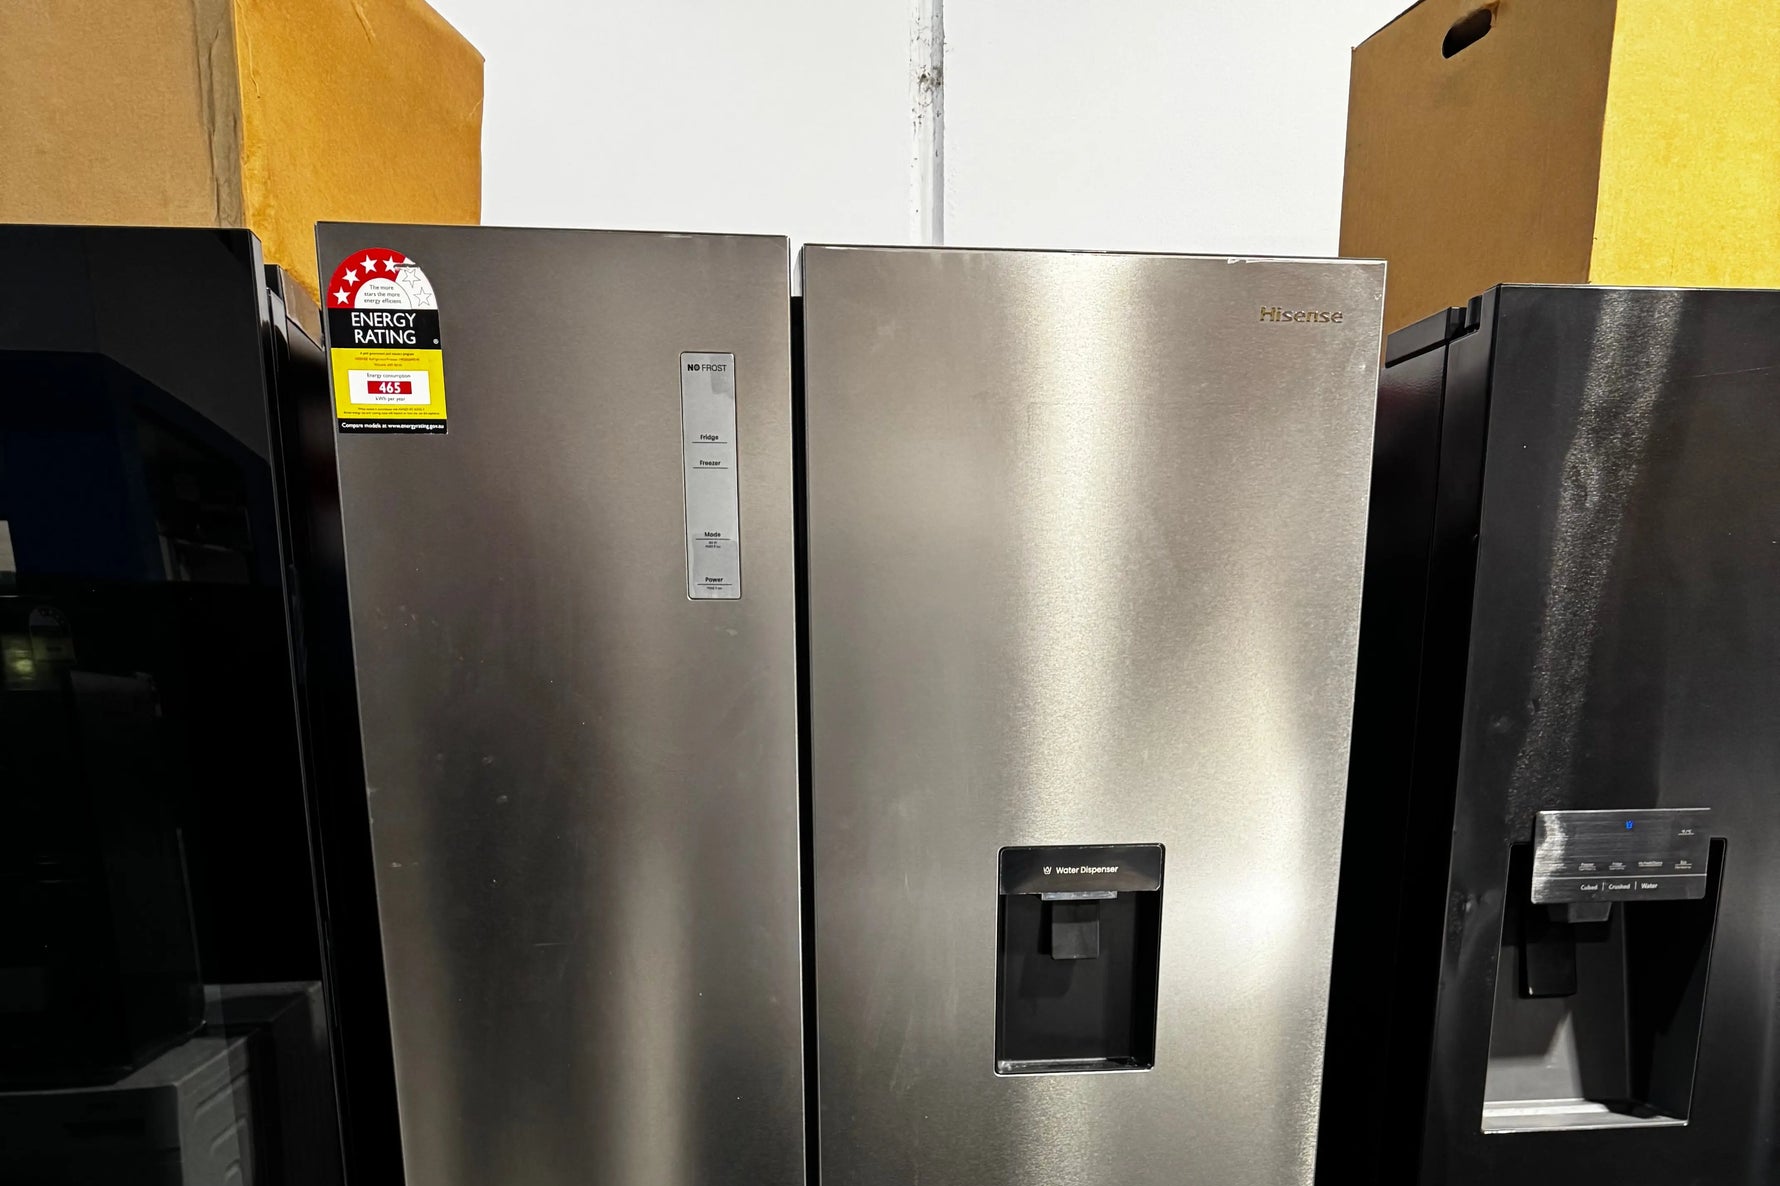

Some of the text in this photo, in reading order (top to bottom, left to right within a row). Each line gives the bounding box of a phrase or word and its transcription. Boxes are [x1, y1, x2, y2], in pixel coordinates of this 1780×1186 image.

[351, 312, 416, 328] ENERGY
[1259, 305, 1344, 324] Hisense
[354, 329, 416, 345] RATING
[687, 363, 728, 372] NO FROST
[379, 381, 401, 394] 465
[1056, 866, 1119, 875] Water Dispenser
